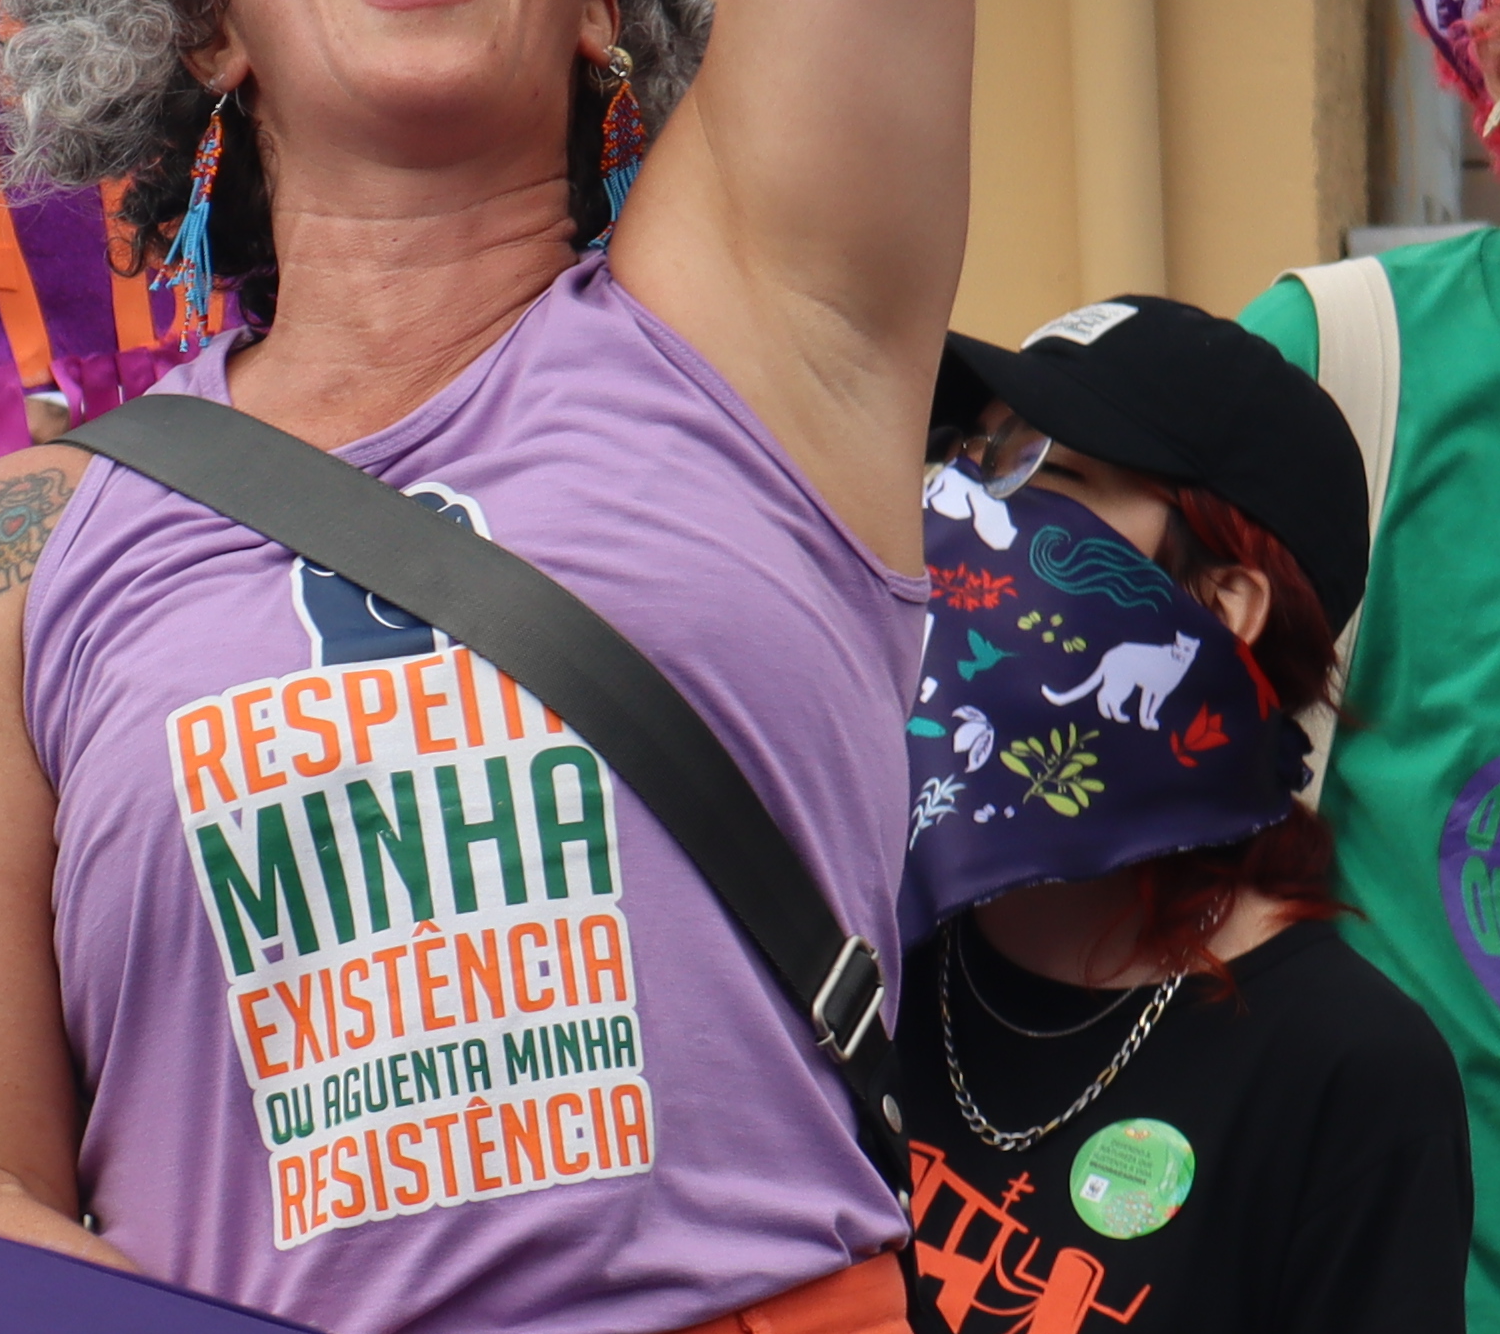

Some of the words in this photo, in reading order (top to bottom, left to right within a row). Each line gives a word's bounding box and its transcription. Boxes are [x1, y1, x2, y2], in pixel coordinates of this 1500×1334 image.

[195, 745, 613, 976] MINHA
[236, 913, 627, 1079] EXISTÊNCIA
[266, 1086, 316, 1145] OU
[325, 1039, 492, 1131] AGUENTA
[505, 1015, 637, 1086] MINHA
[278, 1083, 652, 1241] RESISTÊNCIA
